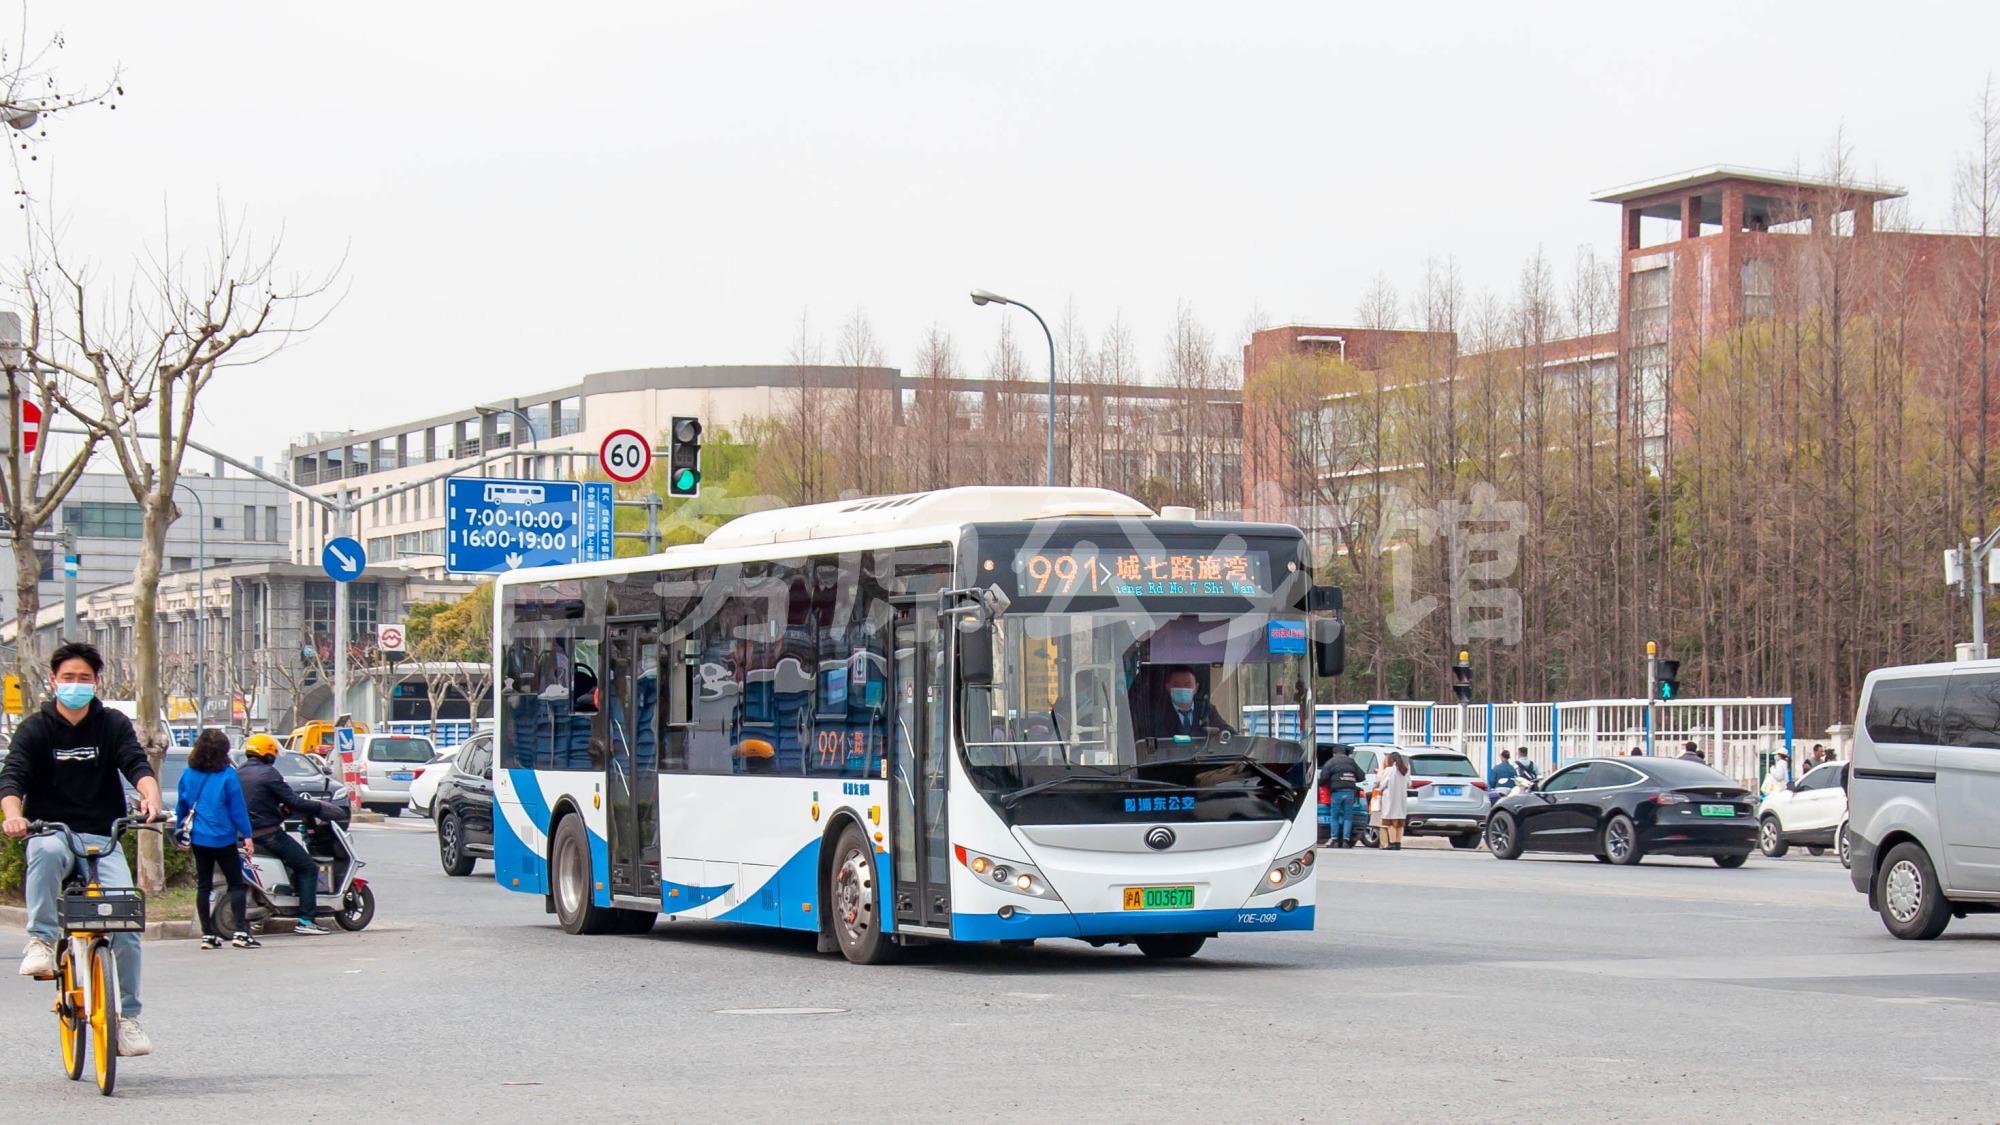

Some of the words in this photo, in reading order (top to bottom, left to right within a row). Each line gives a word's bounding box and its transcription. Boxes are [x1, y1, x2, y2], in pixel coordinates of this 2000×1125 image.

[611, 444, 640, 468] 60
[465, 508, 563, 529] 7:00-10:00
[462, 530, 566, 550] 16:00-19:00
[1028, 555, 1097, 593] 991
[1148, 582, 1164, 594] Rd
[1204, 582, 1224, 594] Shi
[1231, 582, 1255, 595] Wan
[818, 730, 845, 766] 991
[1138, 796, 1195, 811] 浦东公交
